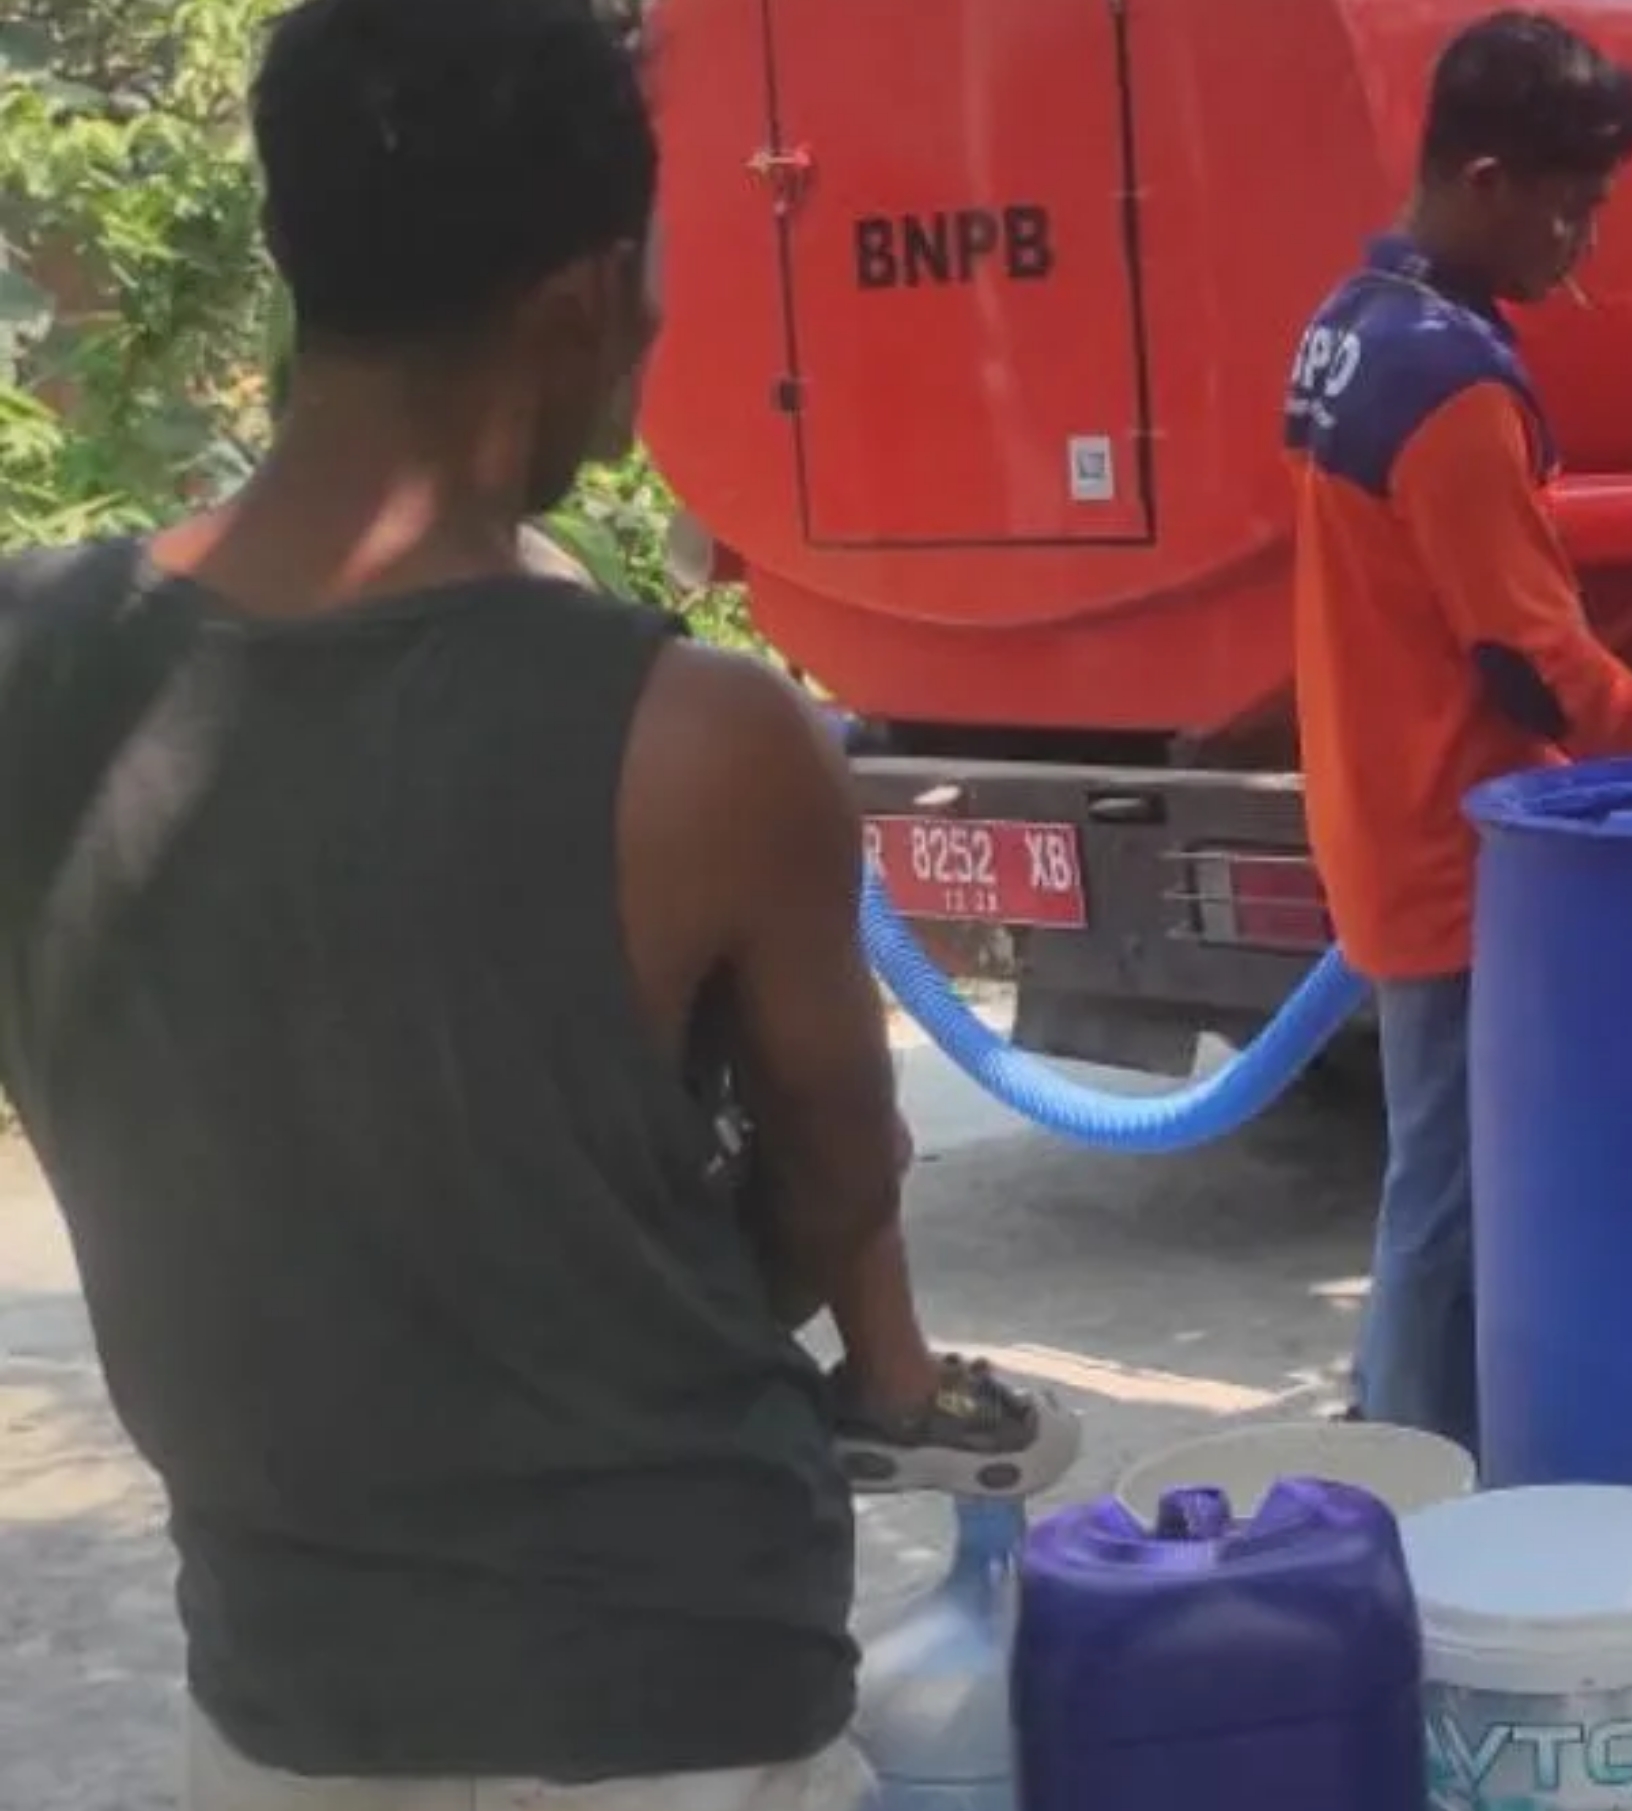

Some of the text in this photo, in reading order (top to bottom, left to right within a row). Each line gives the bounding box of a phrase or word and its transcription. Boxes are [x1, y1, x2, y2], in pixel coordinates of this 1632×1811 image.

[856, 205, 1053, 287] BNPB
[912, 825, 995, 884] 8252
[1025, 829, 1073, 892] XB
